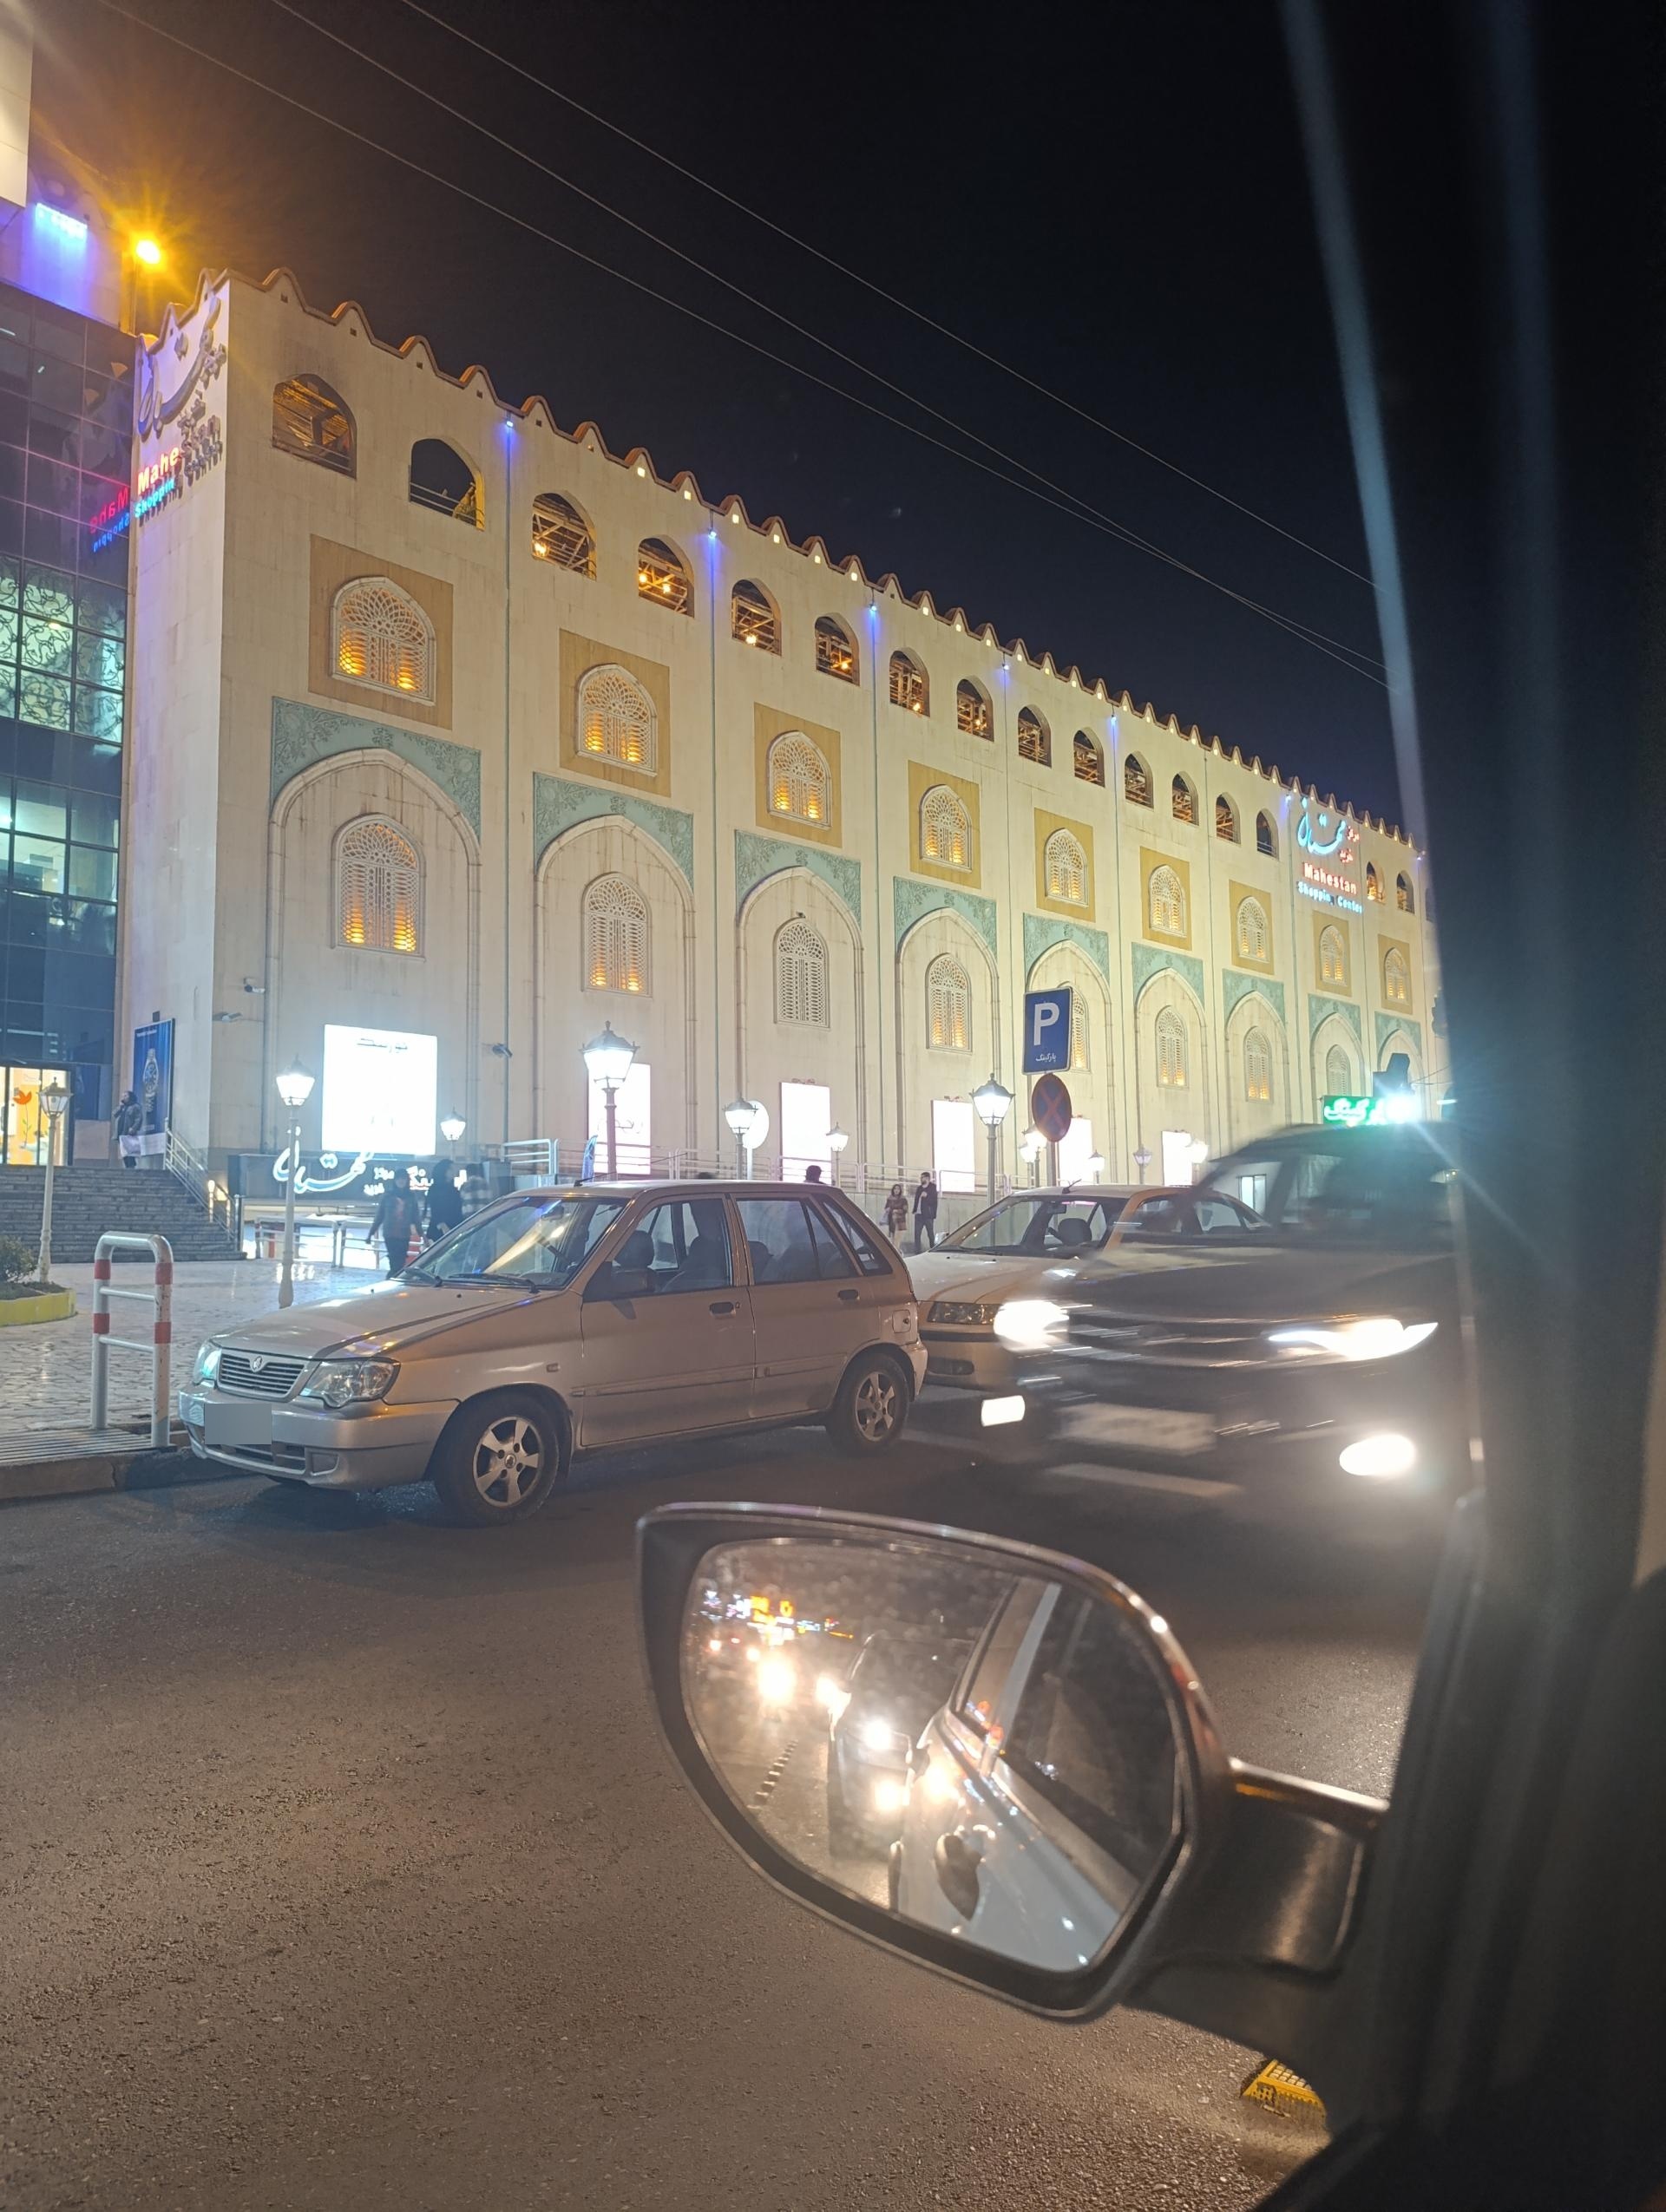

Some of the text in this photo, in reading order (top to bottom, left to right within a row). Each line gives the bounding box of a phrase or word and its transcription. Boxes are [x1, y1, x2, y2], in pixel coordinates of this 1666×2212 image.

[1304, 862, 1357, 895] Mahestan
[1337, 895, 1363, 914] Center
[1033, 1002, 1059, 1046] P
[1035, 1052, 1057, 1063] پارکینگ
